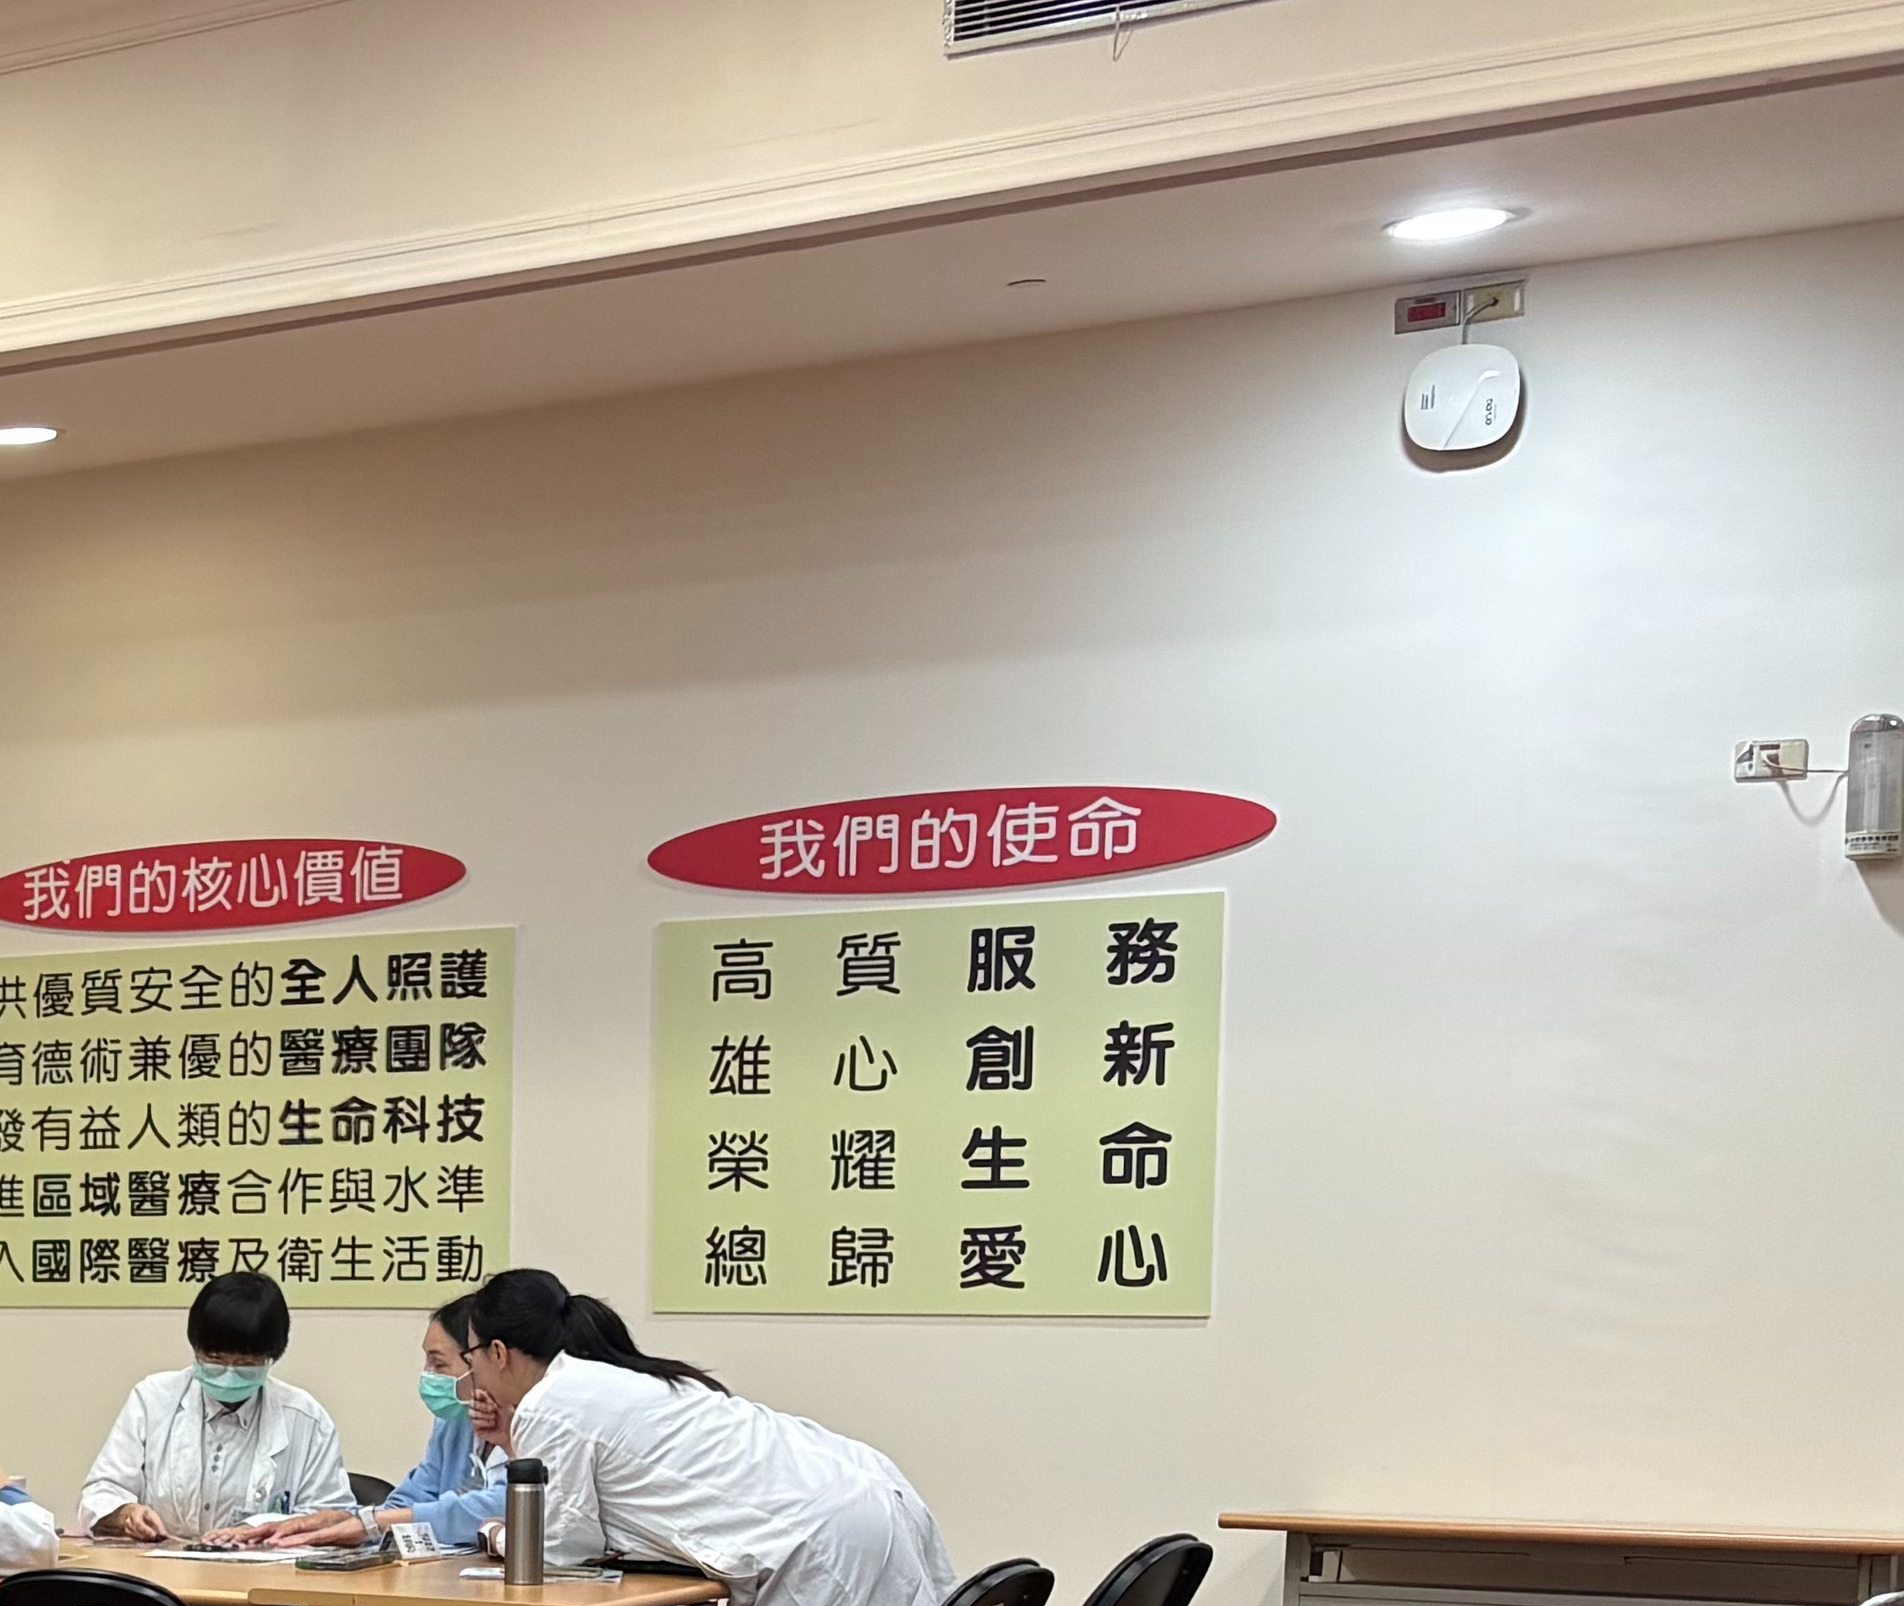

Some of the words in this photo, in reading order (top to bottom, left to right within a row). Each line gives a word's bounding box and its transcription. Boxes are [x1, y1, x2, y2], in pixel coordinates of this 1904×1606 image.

[759, 796, 1143, 881] 我們的使命
[23, 845, 404, 921] 我們的核心價值
